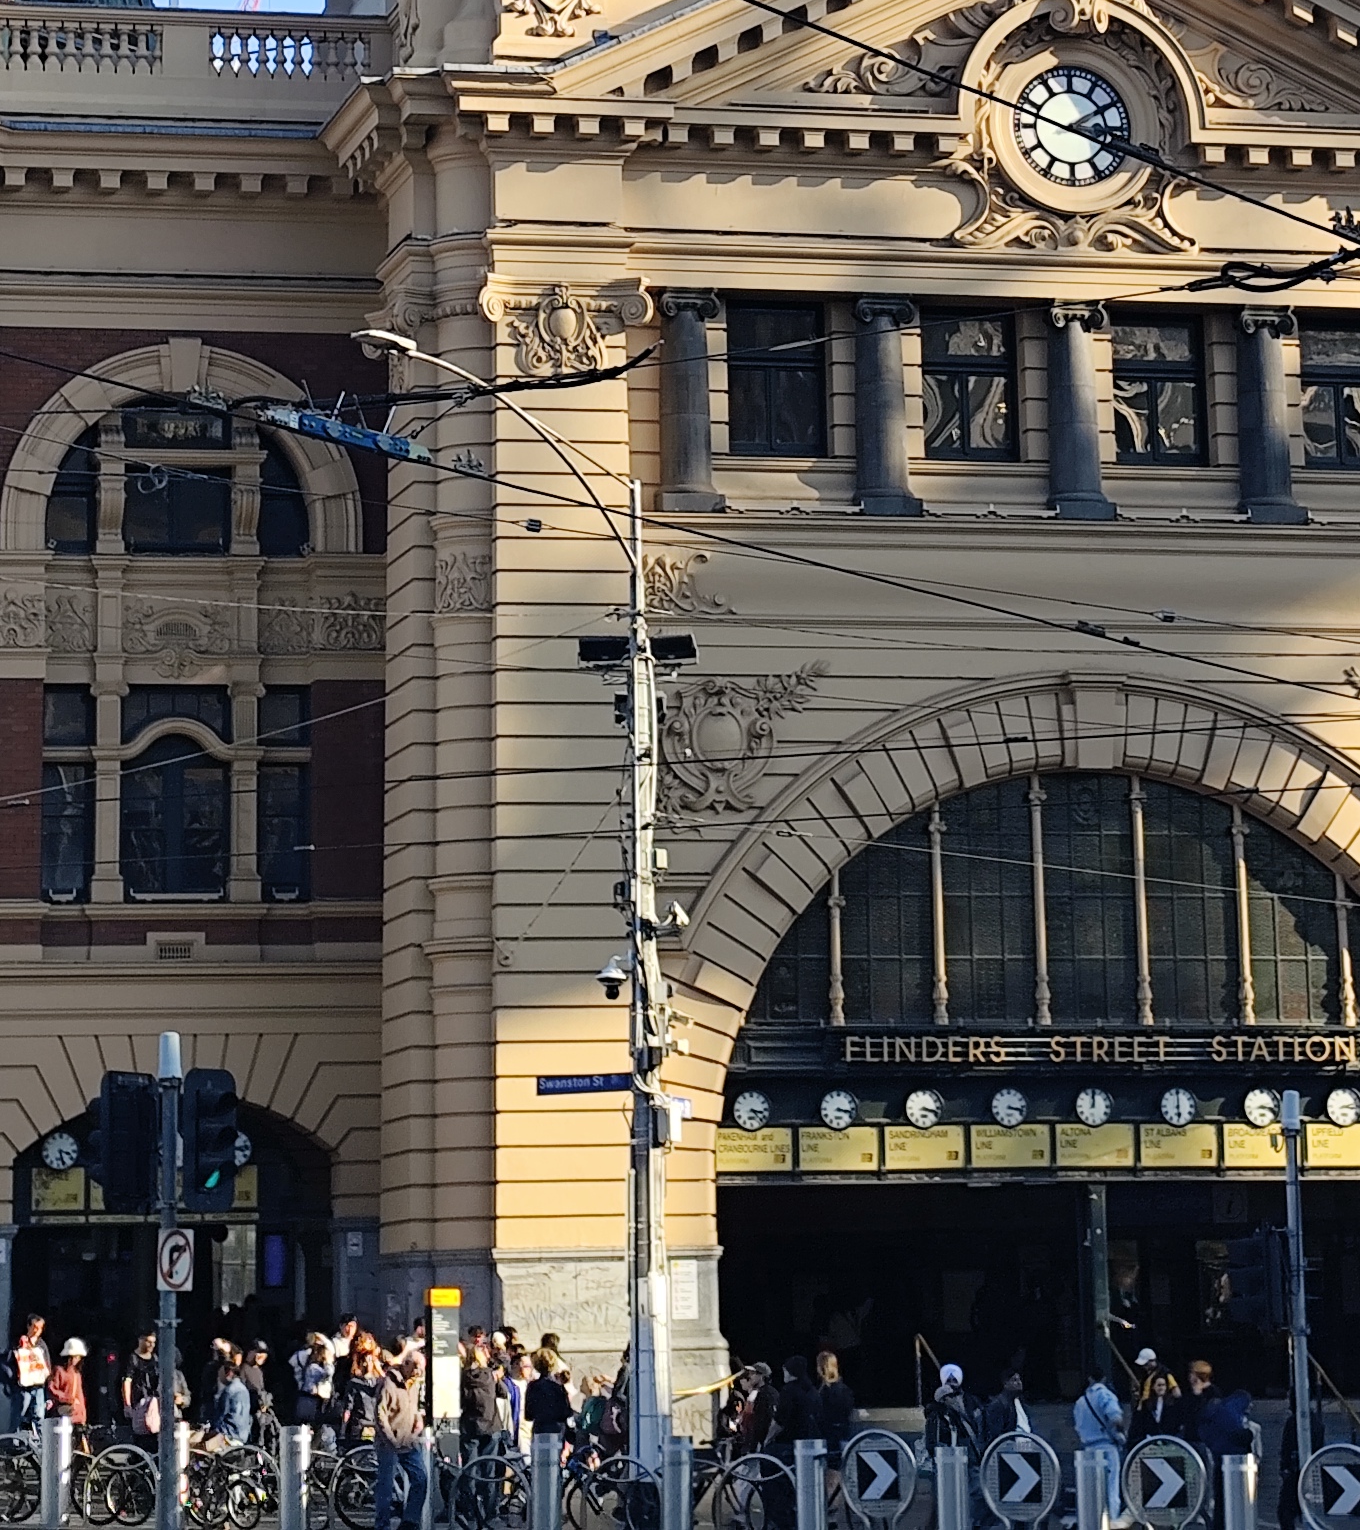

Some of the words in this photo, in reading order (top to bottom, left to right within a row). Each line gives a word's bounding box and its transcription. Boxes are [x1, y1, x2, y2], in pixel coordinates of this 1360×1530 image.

[845, 1035, 1006, 1063] FLINDERS
[1050, 1035, 1170, 1063] STREET
[1211, 1035, 1357, 1063] STATION
[539, 1076, 590, 1090] Swanston
[592, 1075, 604, 1087] St
[717, 1131, 758, 1141] PAKENHAM
[801, 1131, 850, 1141] FRANKSTON
[889, 1129, 949, 1139] SANDRINGHAM
[975, 1128, 1037, 1138] WILLIAMSTOWN
[1060, 1127, 1092, 1137] ALTONA
[1143, 1127, 1155, 1137] ST
[1156, 1127, 1187, 1137] ALBANS
[1311, 1127, 1344, 1137] UPFIELD
[718, 1143, 769, 1154] CRANBOURNE
[770, 1143, 791, 1154] LINES
[801, 1143, 820, 1154] LINE
[889, 1141, 907, 1151] LINE
[975, 1140, 993, 1150] LINE
[1060, 1139, 1078, 1149] LINE
[1144, 1139, 1162, 1149] LINE
[1228, 1139, 1246, 1149] LINE
[1311, 1139, 1330, 1148] LINE
